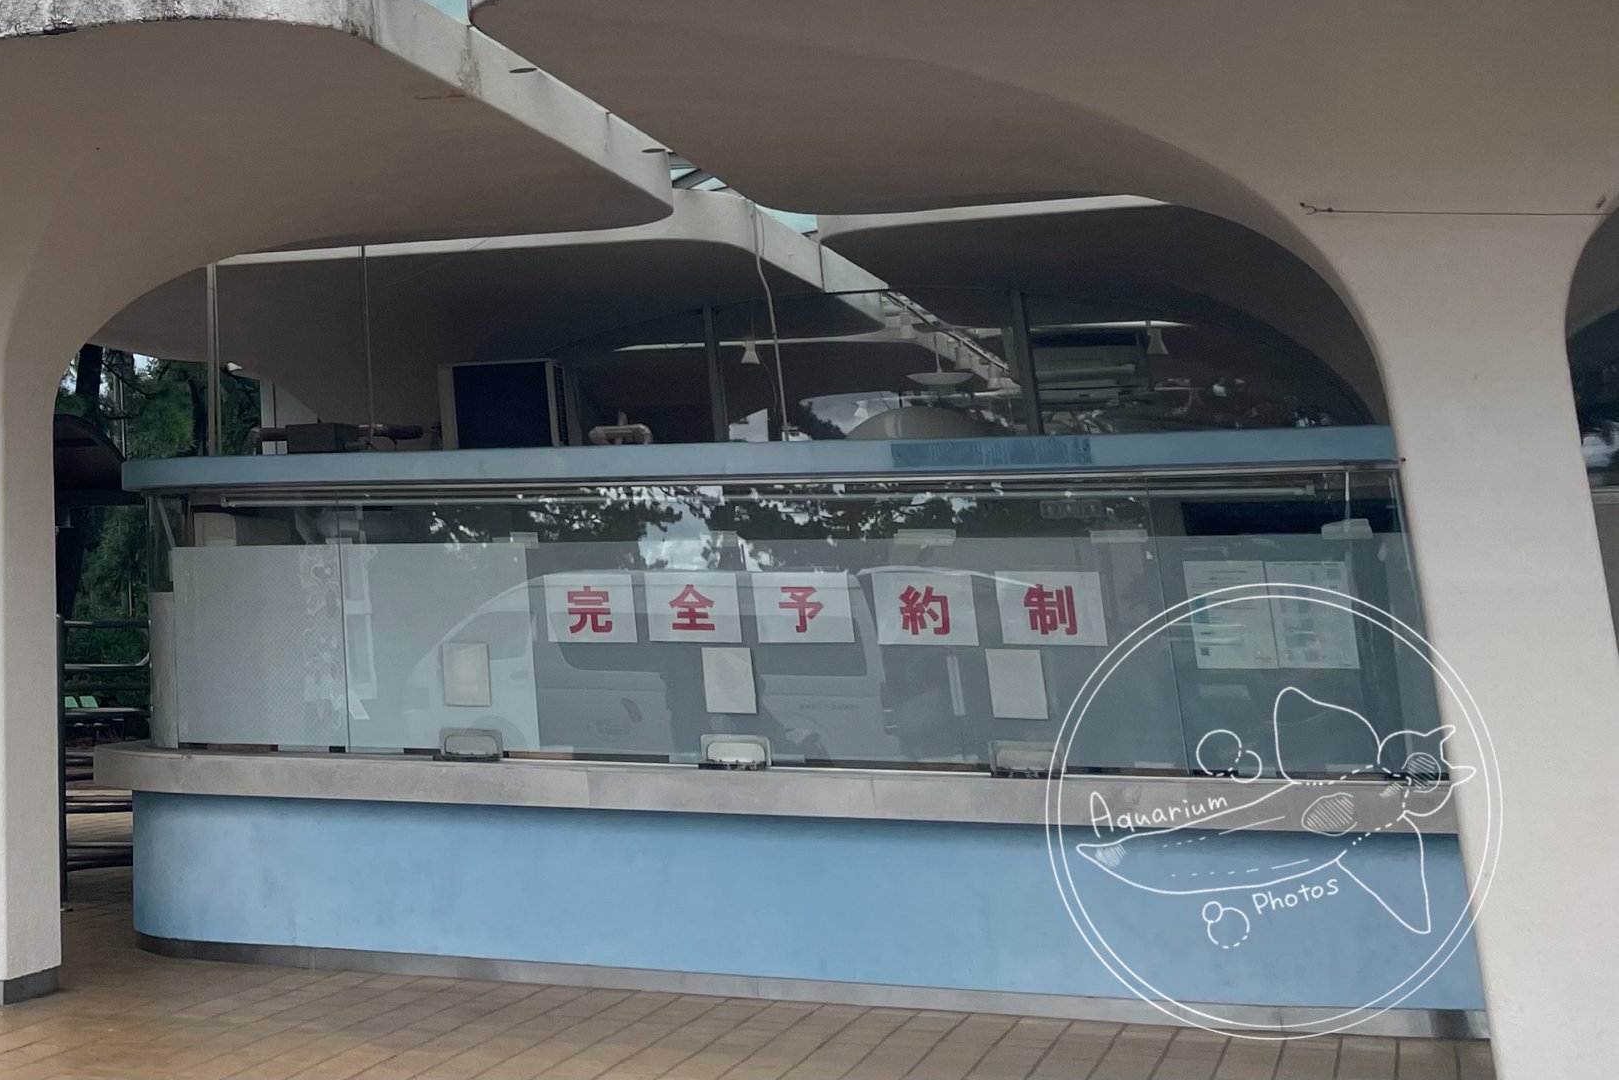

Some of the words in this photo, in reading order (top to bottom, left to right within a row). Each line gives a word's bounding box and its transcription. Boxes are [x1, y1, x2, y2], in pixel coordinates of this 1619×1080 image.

[567, 583, 1078, 636] 完全予約制
